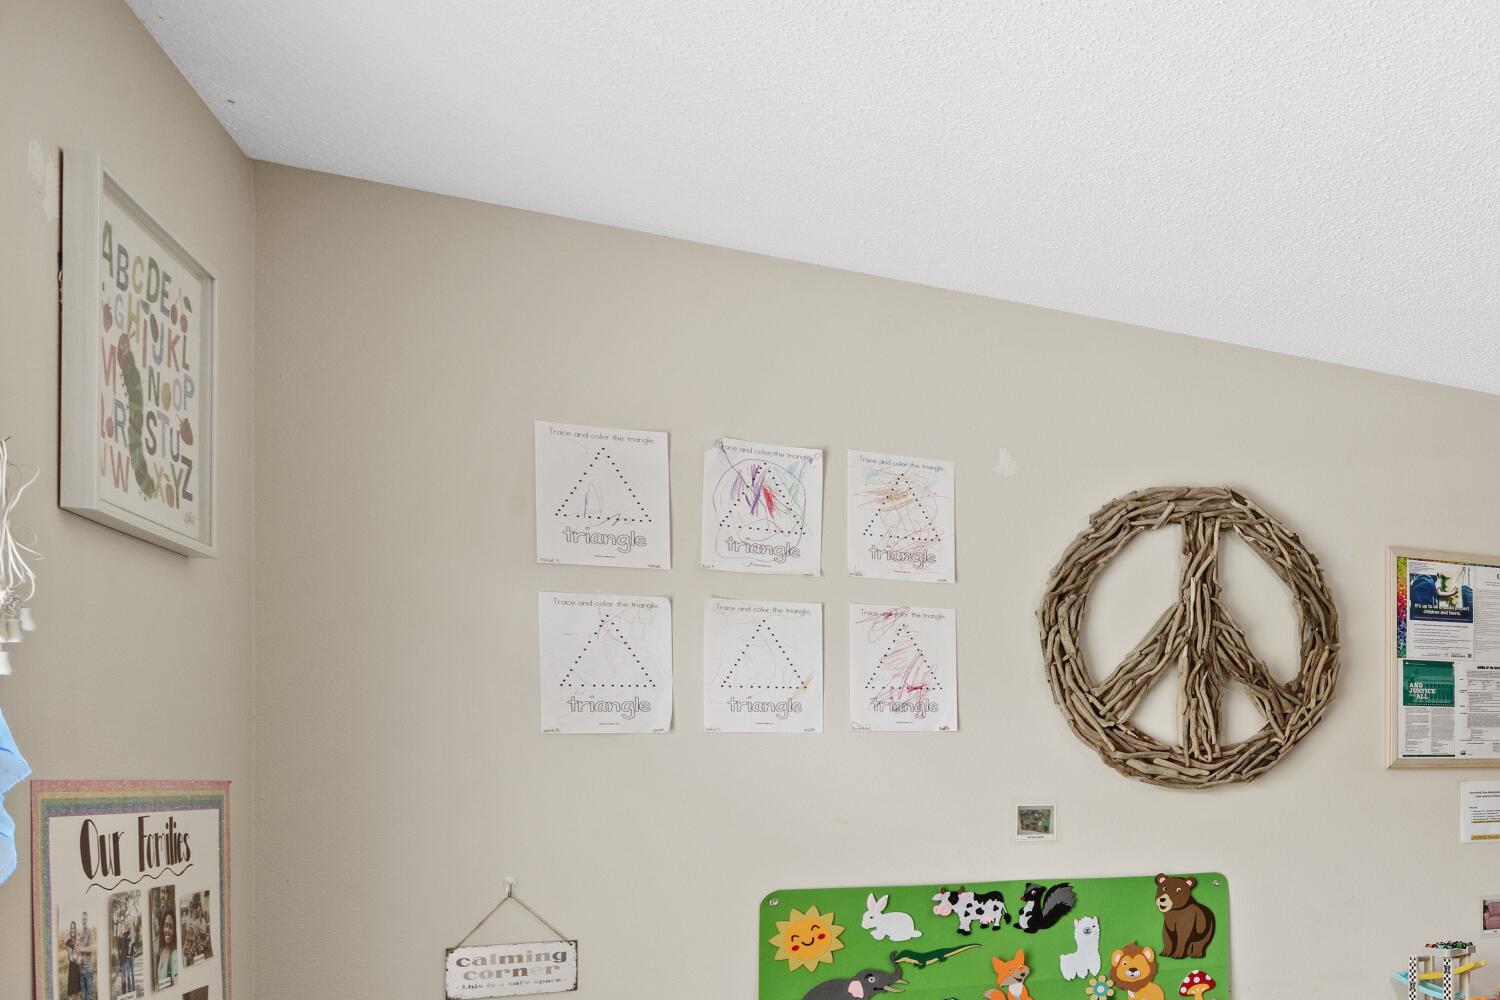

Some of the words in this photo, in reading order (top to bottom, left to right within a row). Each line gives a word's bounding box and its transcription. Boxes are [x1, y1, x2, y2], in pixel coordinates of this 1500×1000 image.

[548, 426, 572, 437] Trace
[573, 431, 589, 439] and
[591, 432, 609, 441] color
[612, 433, 624, 442] the
[739, 446, 753, 454] and
[562, 525, 648, 554] triangle
[725, 535, 801, 564] triangle
[869, 544, 937, 569] triangle
[553, 597, 576, 606] Trace
[616, 600, 629, 608] the
[716, 603, 736, 612] Trace
[772, 606, 783, 614] the
[567, 695, 651, 720] triangle
[727, 696, 803, 720] triangle
[79, 817, 124, 881] Our
[137, 815, 192, 873] Families
[456, 950, 567, 968] calming
[463, 965, 560, 981] corner
